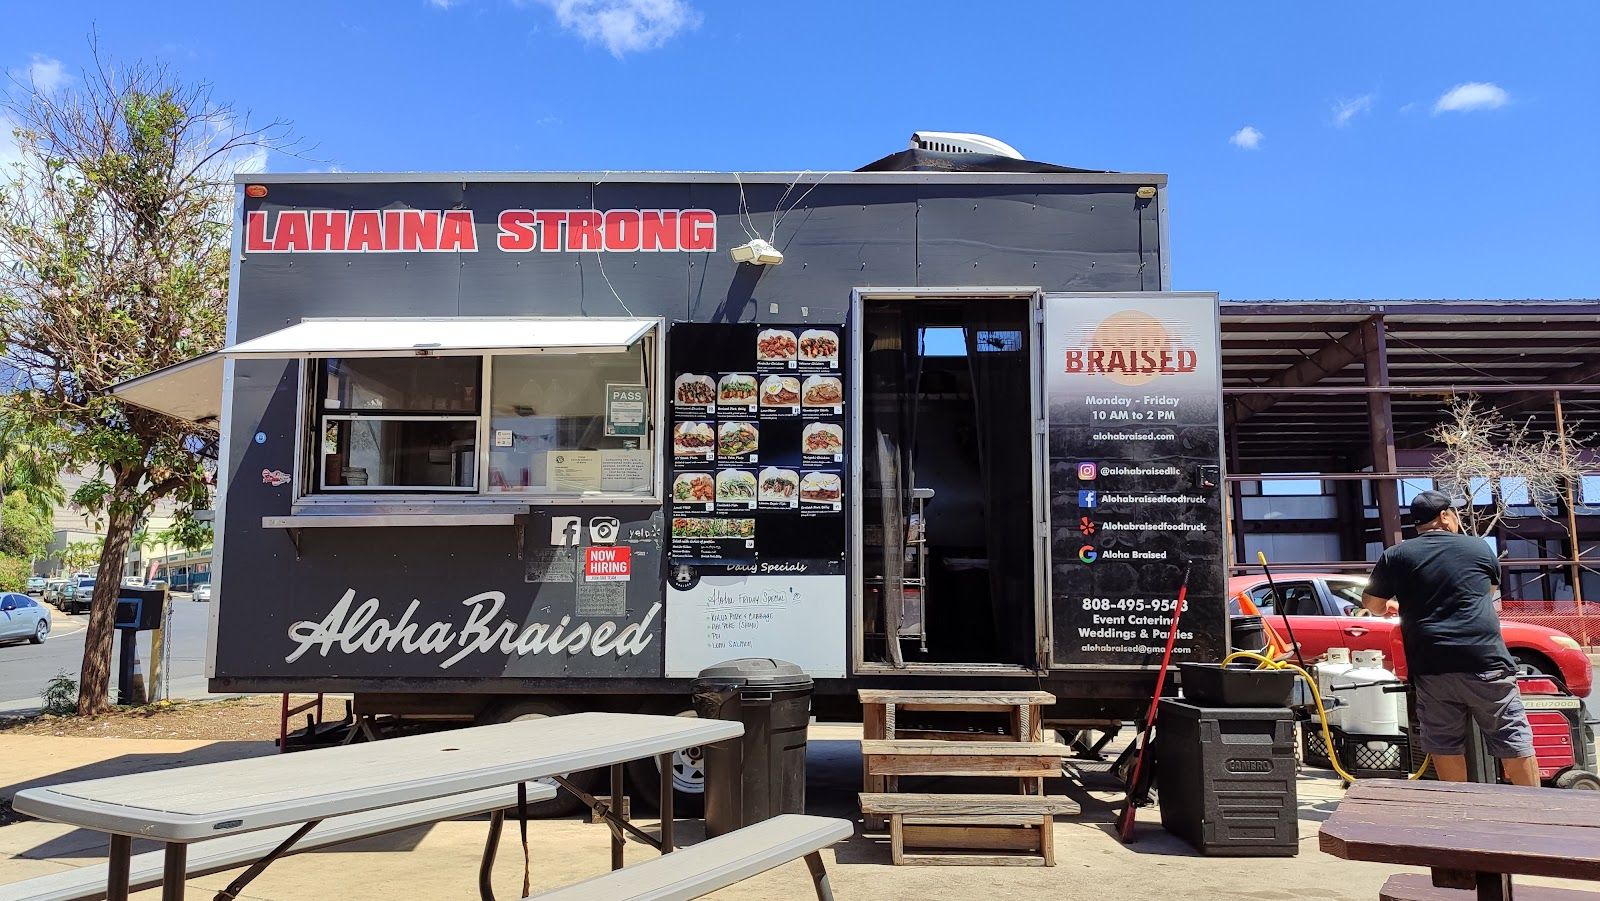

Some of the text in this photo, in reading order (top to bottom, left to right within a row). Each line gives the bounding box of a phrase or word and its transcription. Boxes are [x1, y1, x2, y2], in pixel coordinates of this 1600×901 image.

[245, 208, 717, 253] LAHAINA STRONG
[1065, 348, 1198, 375] BRAISED
[613, 391, 642, 401] PASS
[1085, 395, 1132, 407] Monday
[1143, 395, 1180, 407] Friday
[1092, 411, 1175, 420] 10 AM to 2 PM
[1092, 432, 1175, 441] alohabraised.com
[1100, 466, 1181, 476] @alohabraisedllc
[1101, 494, 1206, 504] Alohabraisedfoodtruck
[1101, 521, 1207, 532] Alohabraisedfoodtruck
[629, 528, 650, 539] yelp
[590, 550, 616, 561] NOW
[1102, 550, 1130, 560] Aloha
[1132, 550, 1167, 560] Braised
[590, 561, 628, 573] HIRING
[760, 561, 808, 574] Specials
[1092, 615, 1125, 625] Event
[284, 587, 456, 664] Aloha
[439, 590, 663, 670] Braised
[1078, 628, 1137, 641] Weddings
[1139, 629, 1149, 639] &
[1081, 644, 1192, 655] alohabraised@gma.com
